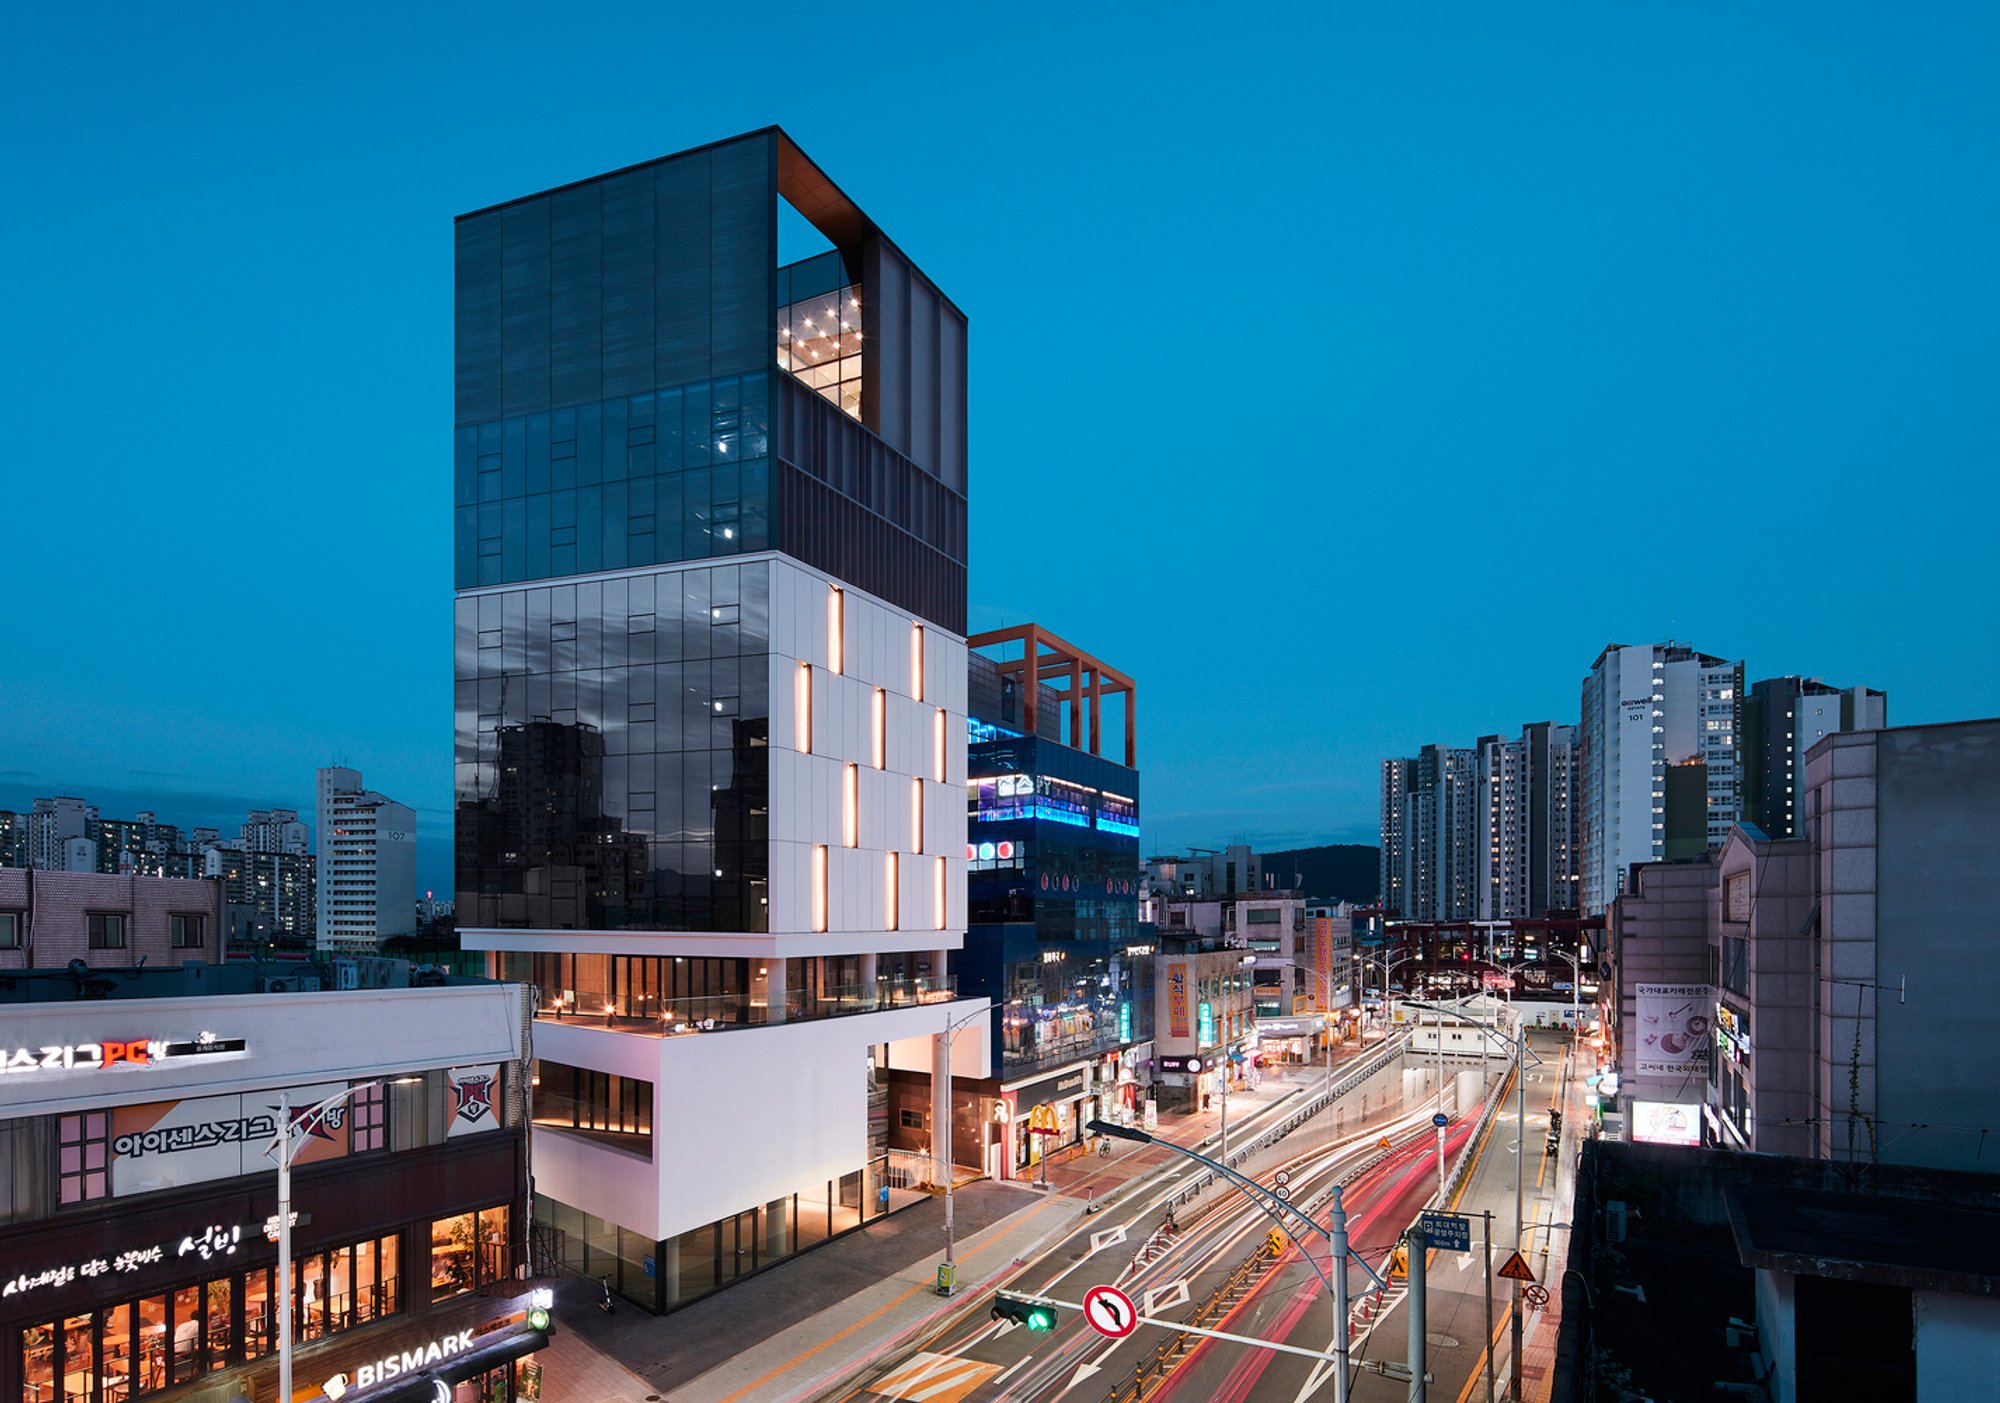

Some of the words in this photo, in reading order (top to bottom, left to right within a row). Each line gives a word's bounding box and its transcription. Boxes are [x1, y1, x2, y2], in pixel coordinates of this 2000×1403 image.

[388, 831, 405, 841] 107
[178, 1225, 240, 1260] 설빙
[357, 1327, 474, 1389] BISMARK
